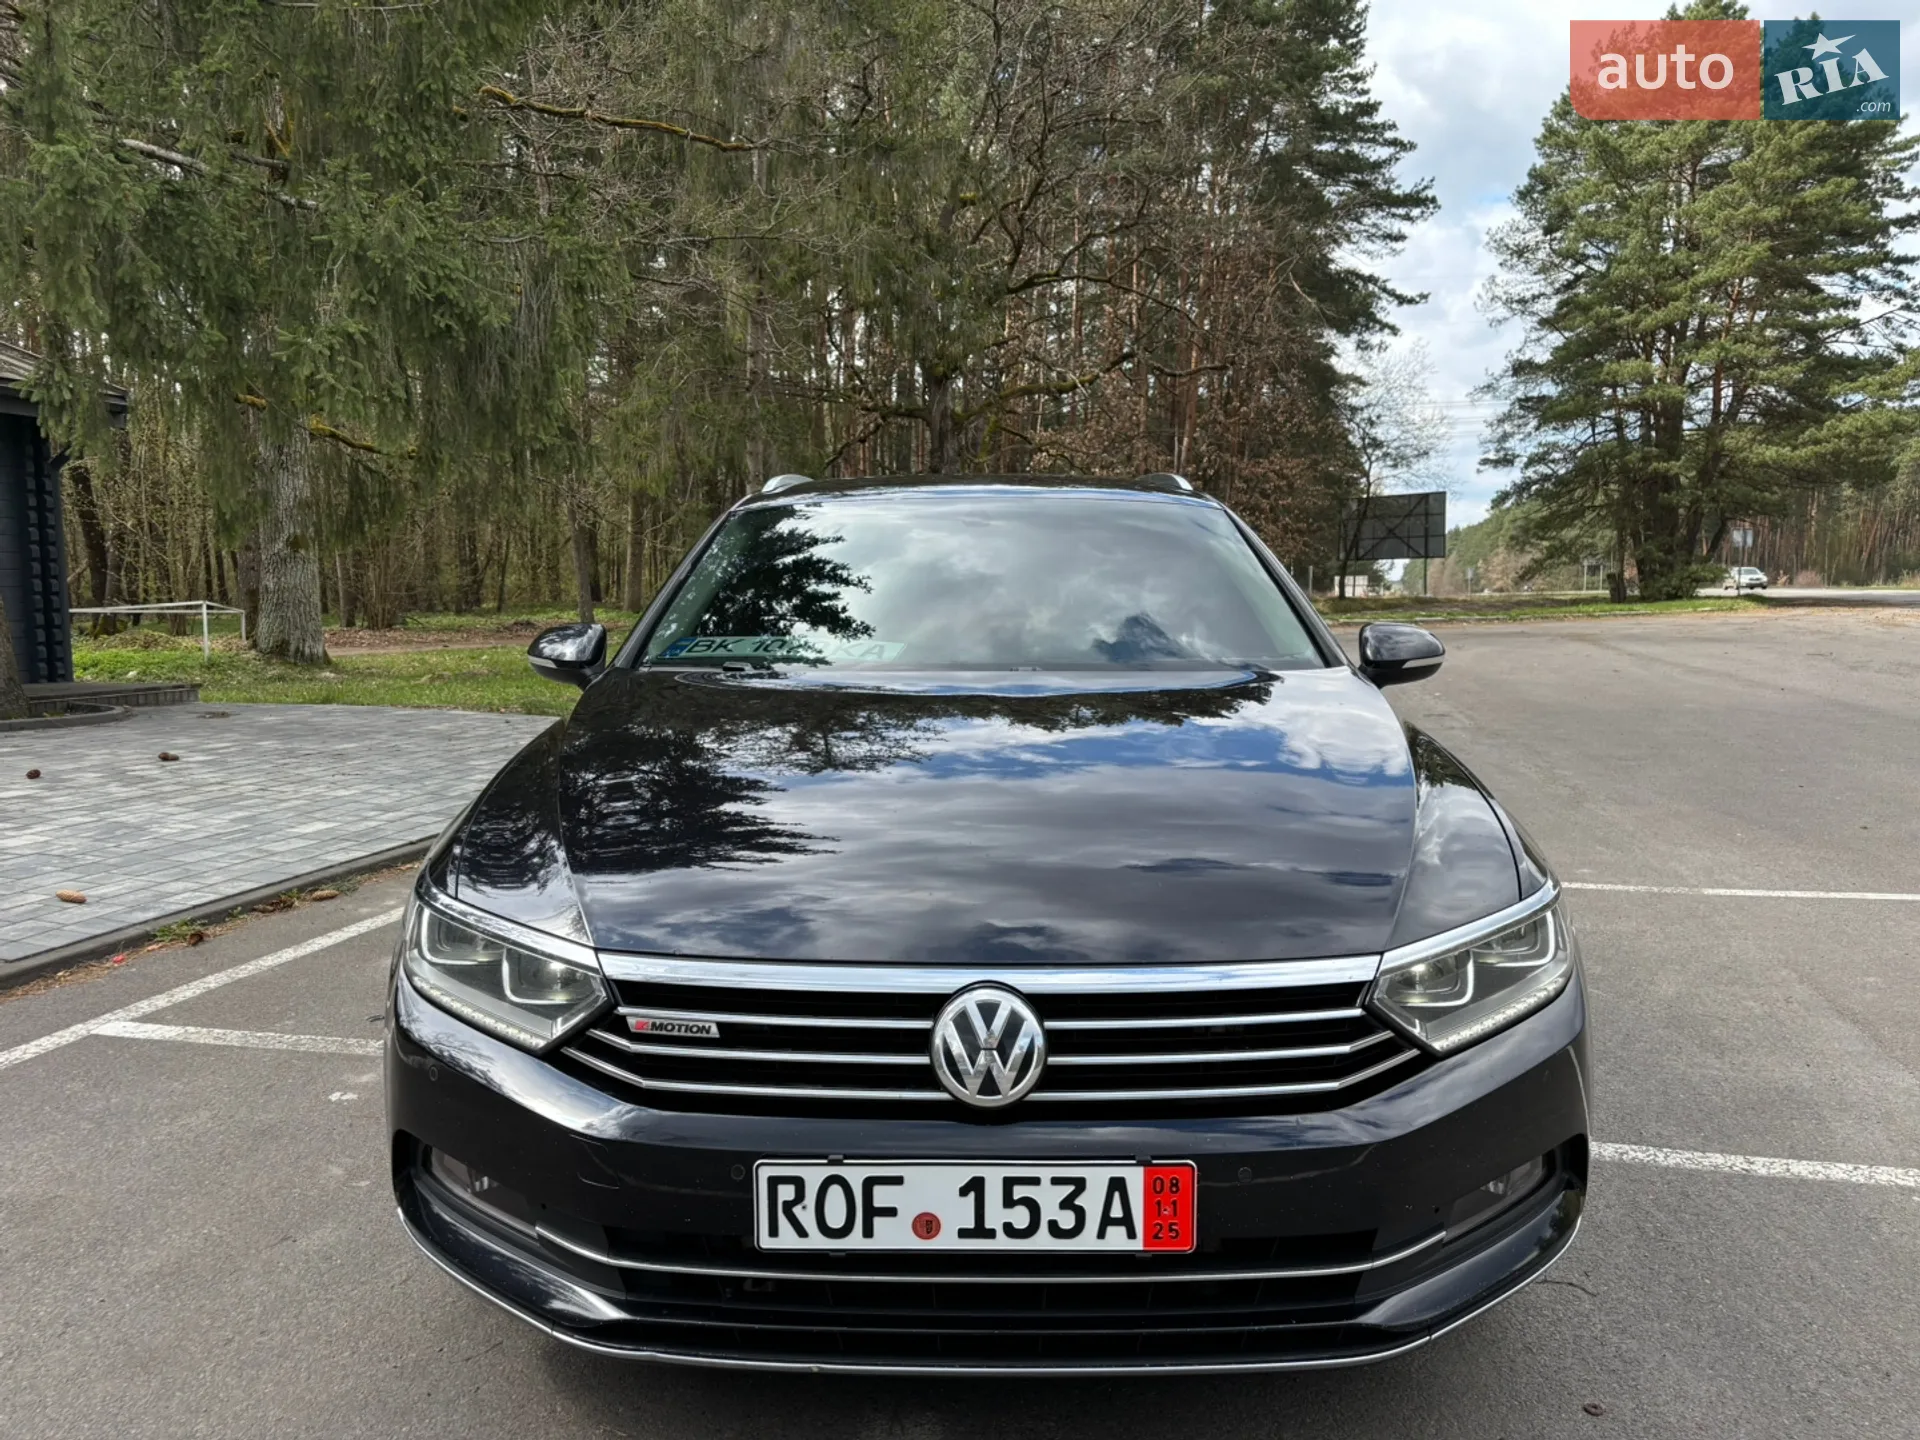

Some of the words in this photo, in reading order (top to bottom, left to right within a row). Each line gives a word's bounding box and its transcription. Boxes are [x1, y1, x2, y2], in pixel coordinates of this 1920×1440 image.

[1152, 1175, 1181, 1195] 08
[766, 1174, 904, 1239] ROF
[957, 1175, 1138, 1240] 153A
[1152, 1221, 1181, 1240] 25
